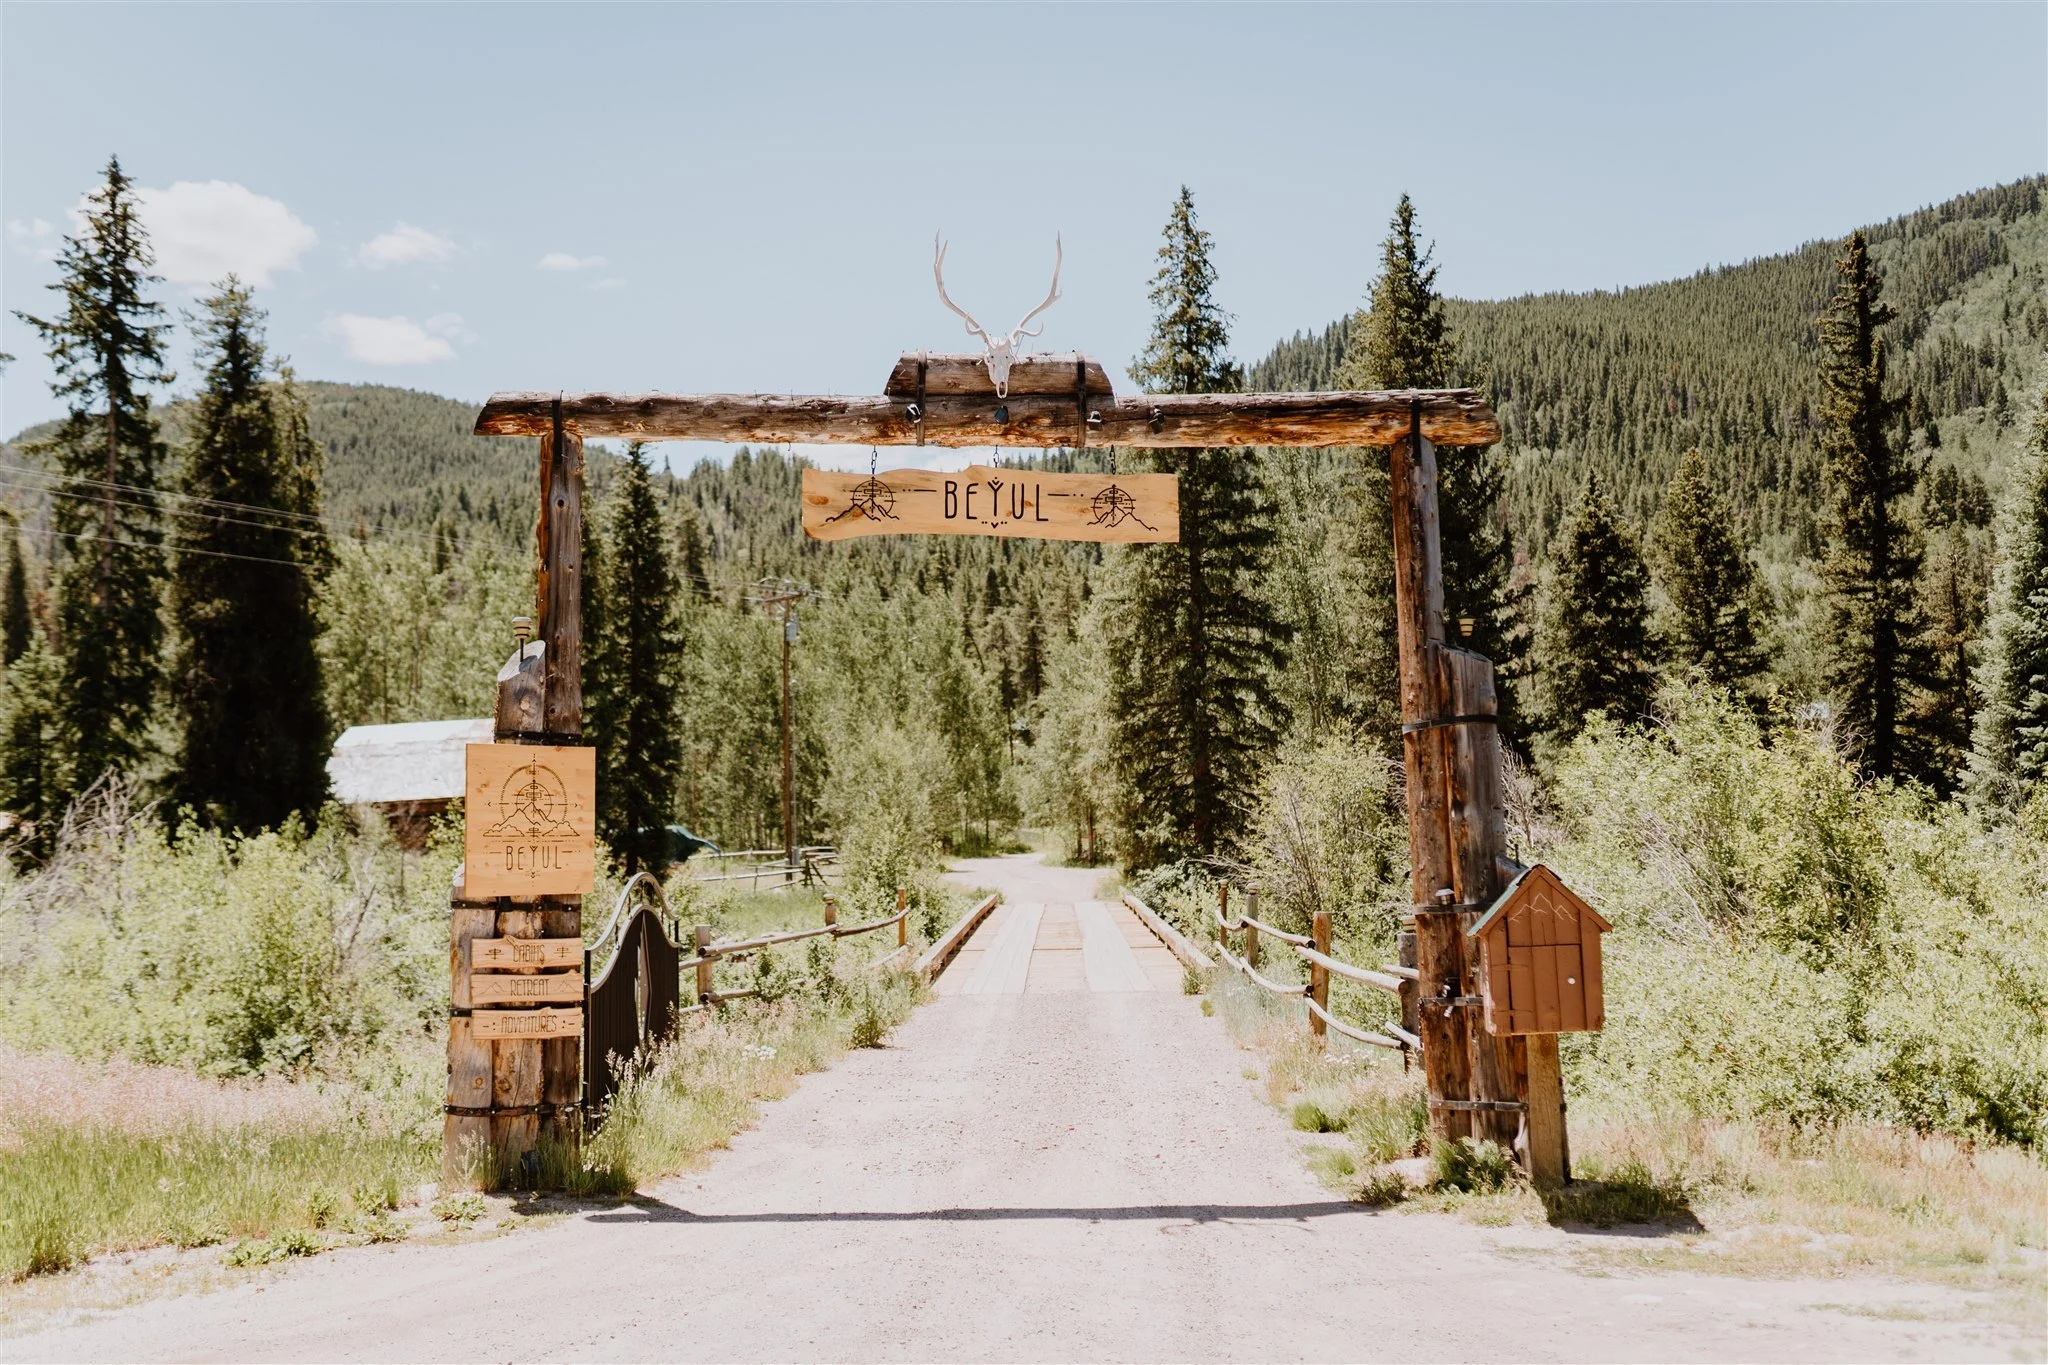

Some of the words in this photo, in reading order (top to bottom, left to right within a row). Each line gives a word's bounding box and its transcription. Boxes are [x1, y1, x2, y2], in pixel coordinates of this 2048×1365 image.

[944, 479, 1049, 521] BEYUL
[505, 845, 562, 870] BEYUL
[512, 944, 545, 963] CABINS
[510, 978, 550, 996] RETREAT
[500, 1015, 558, 1034] ADVENTURES
